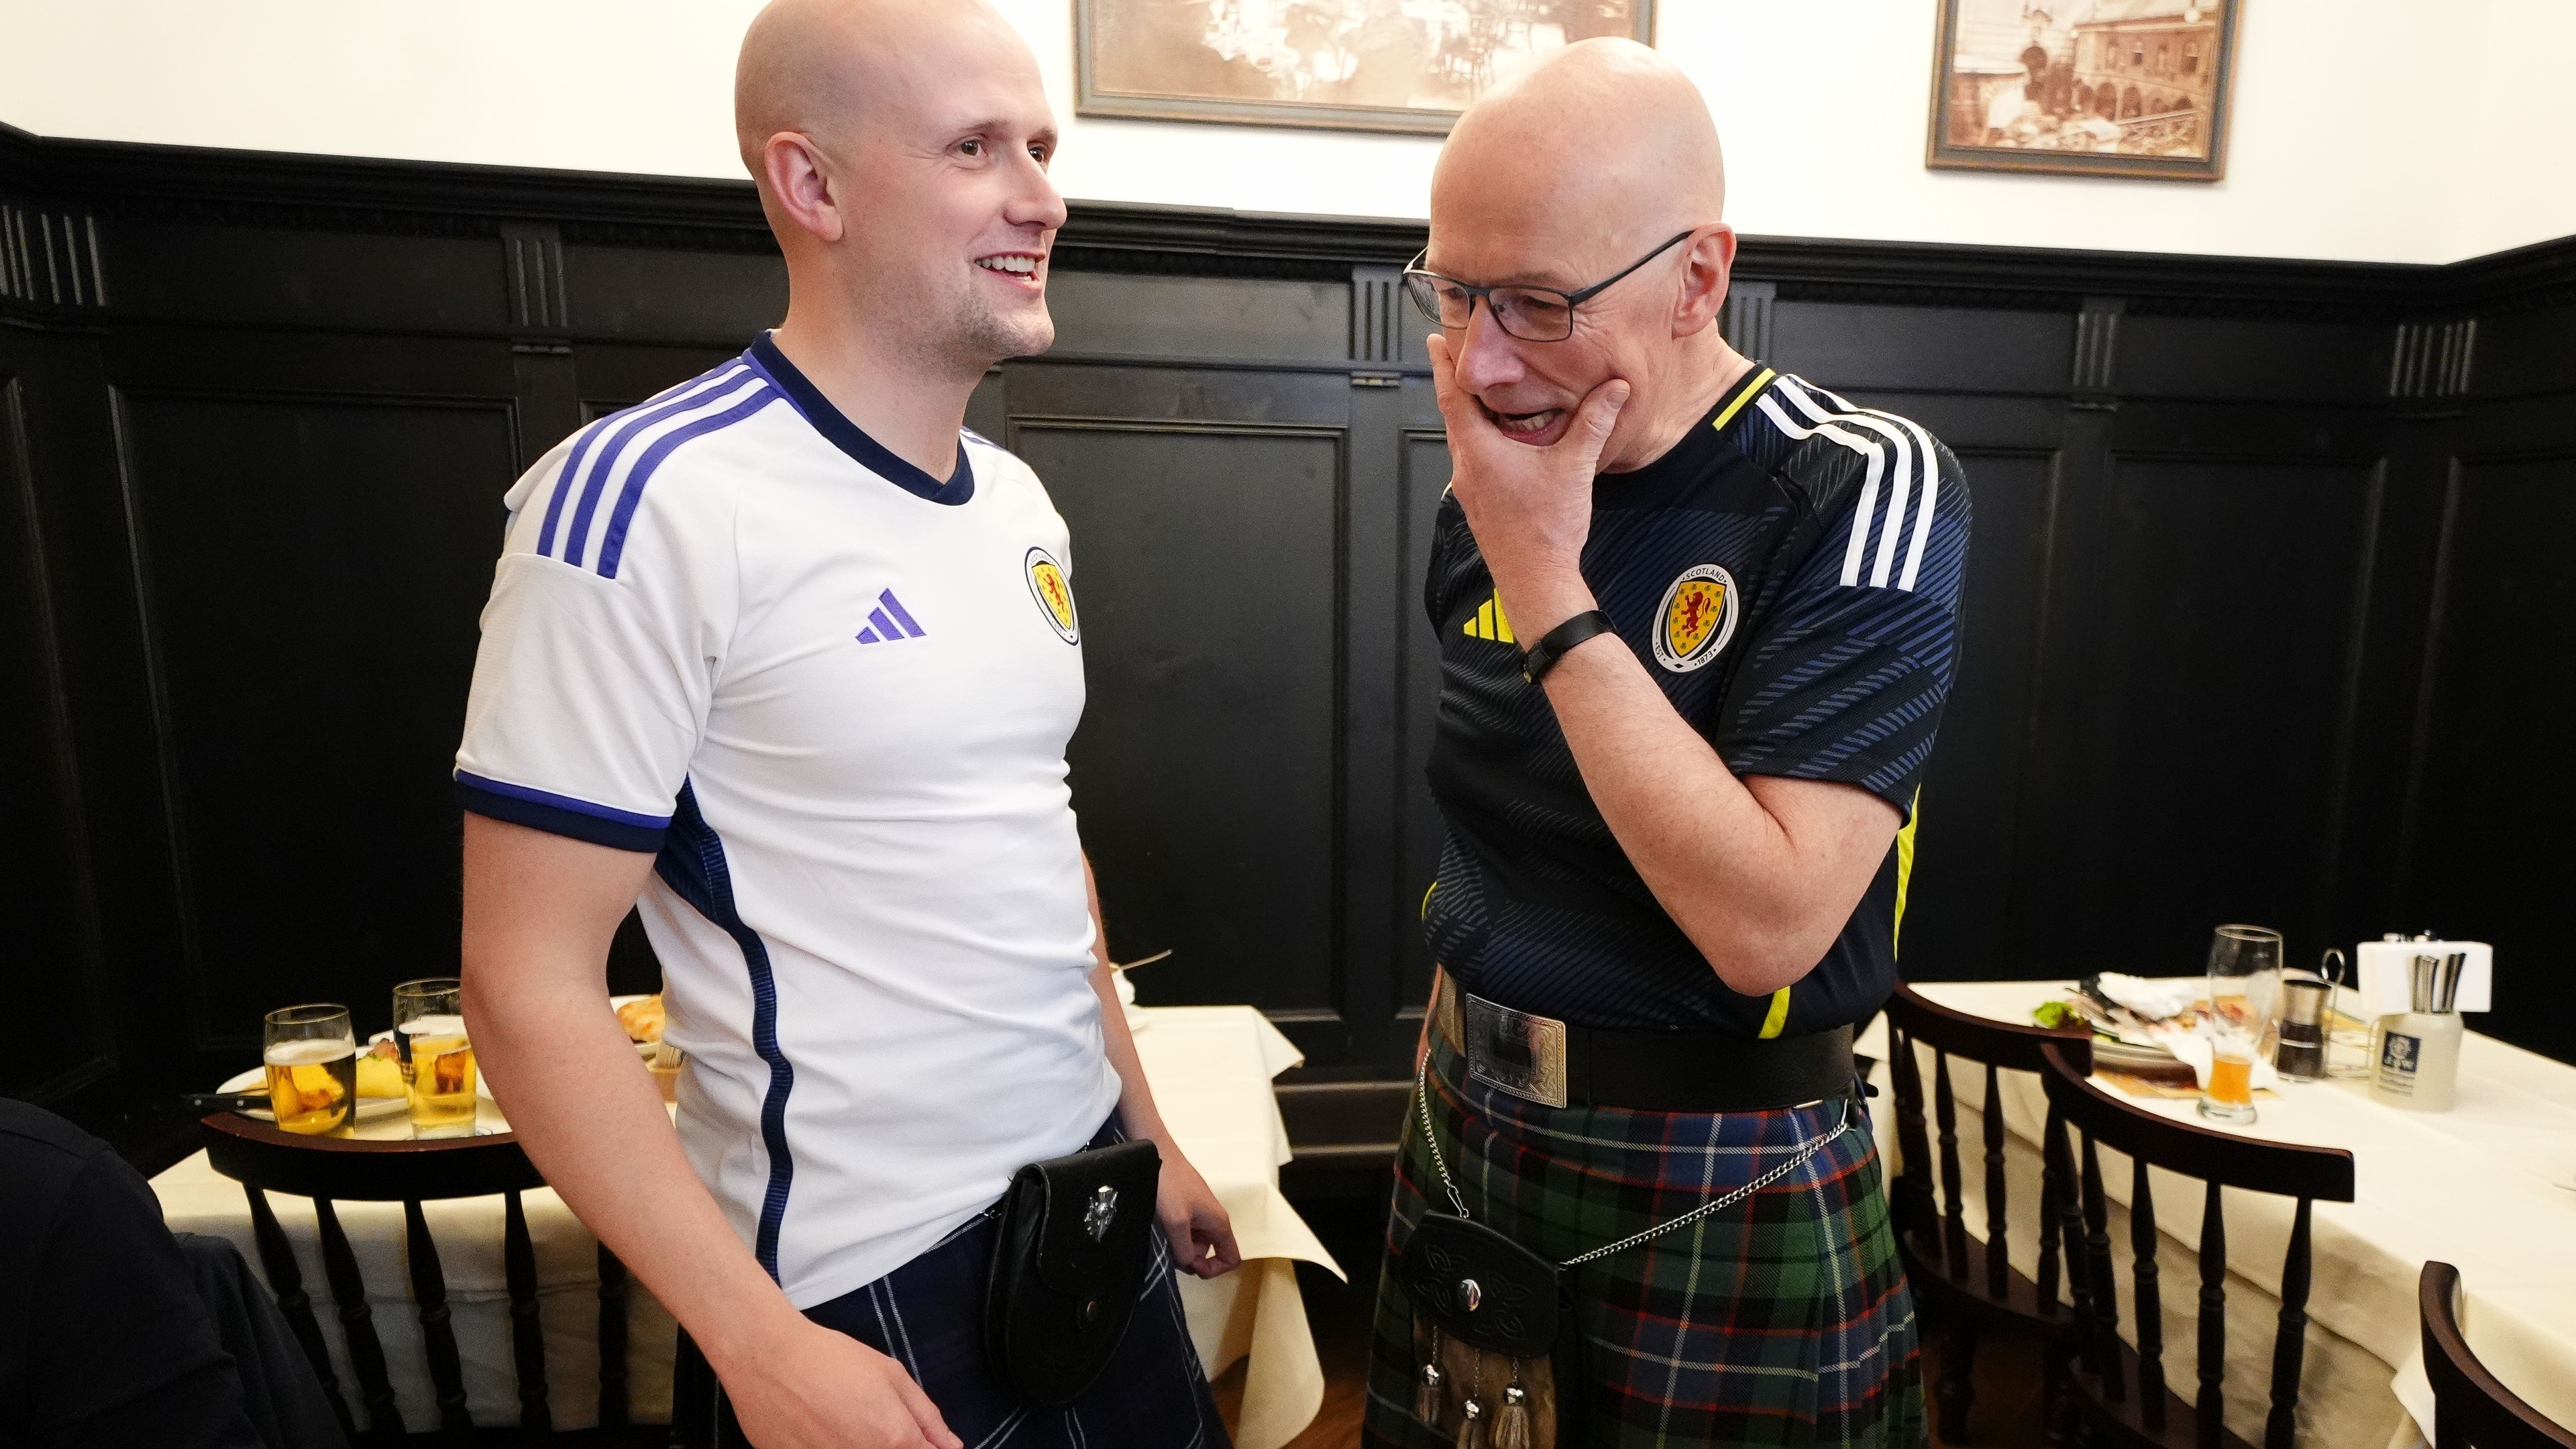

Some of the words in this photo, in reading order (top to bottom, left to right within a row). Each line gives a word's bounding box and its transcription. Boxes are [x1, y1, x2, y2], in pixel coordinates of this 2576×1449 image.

[1686, 568, 1725, 582] SCOTLAND
[1655, 645, 1664, 658] EST
[1697, 651, 1713, 665] 1873
